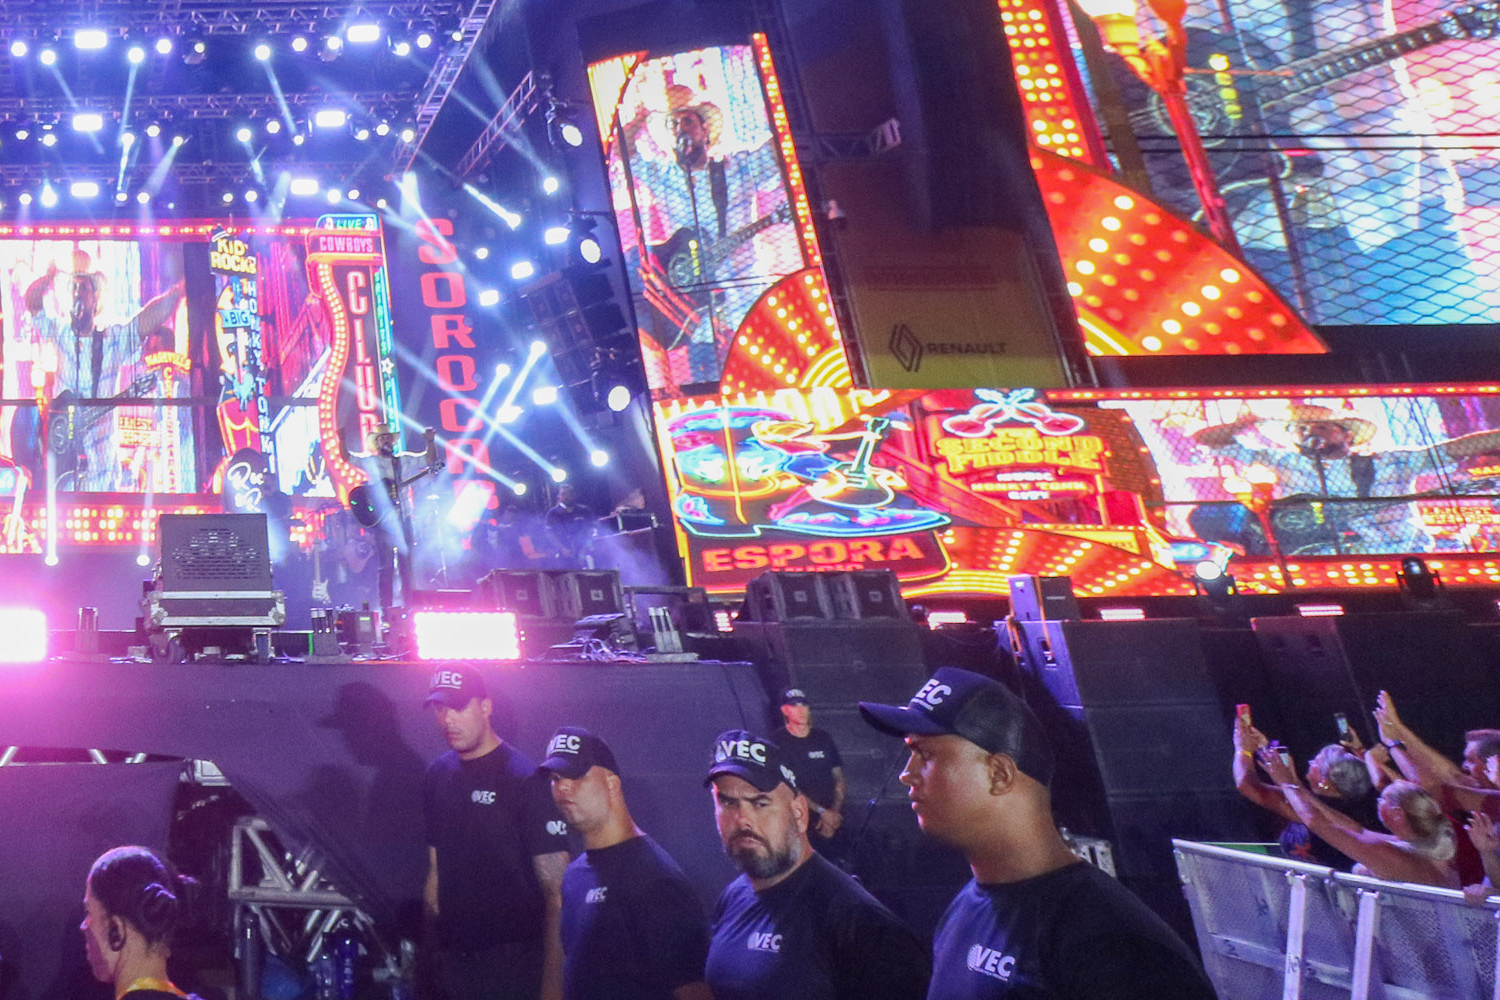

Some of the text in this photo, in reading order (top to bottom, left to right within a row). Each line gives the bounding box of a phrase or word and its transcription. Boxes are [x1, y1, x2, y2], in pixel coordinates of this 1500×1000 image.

[336, 219, 362, 228] LIVE
[217, 239, 246, 256] KID
[320, 236, 373, 252] COWBOYS
[230, 311, 249, 325] BIG
[926, 342, 1007, 354] RENAULT
[936, 436, 1104, 455] SECOND
[947, 450, 1102, 473] FIDDLE
[702, 538, 925, 572] ESPORA
[720, 739, 767, 763] VEC
[754, 931, 783, 950] VEC
[975, 945, 1016, 978] VEC
